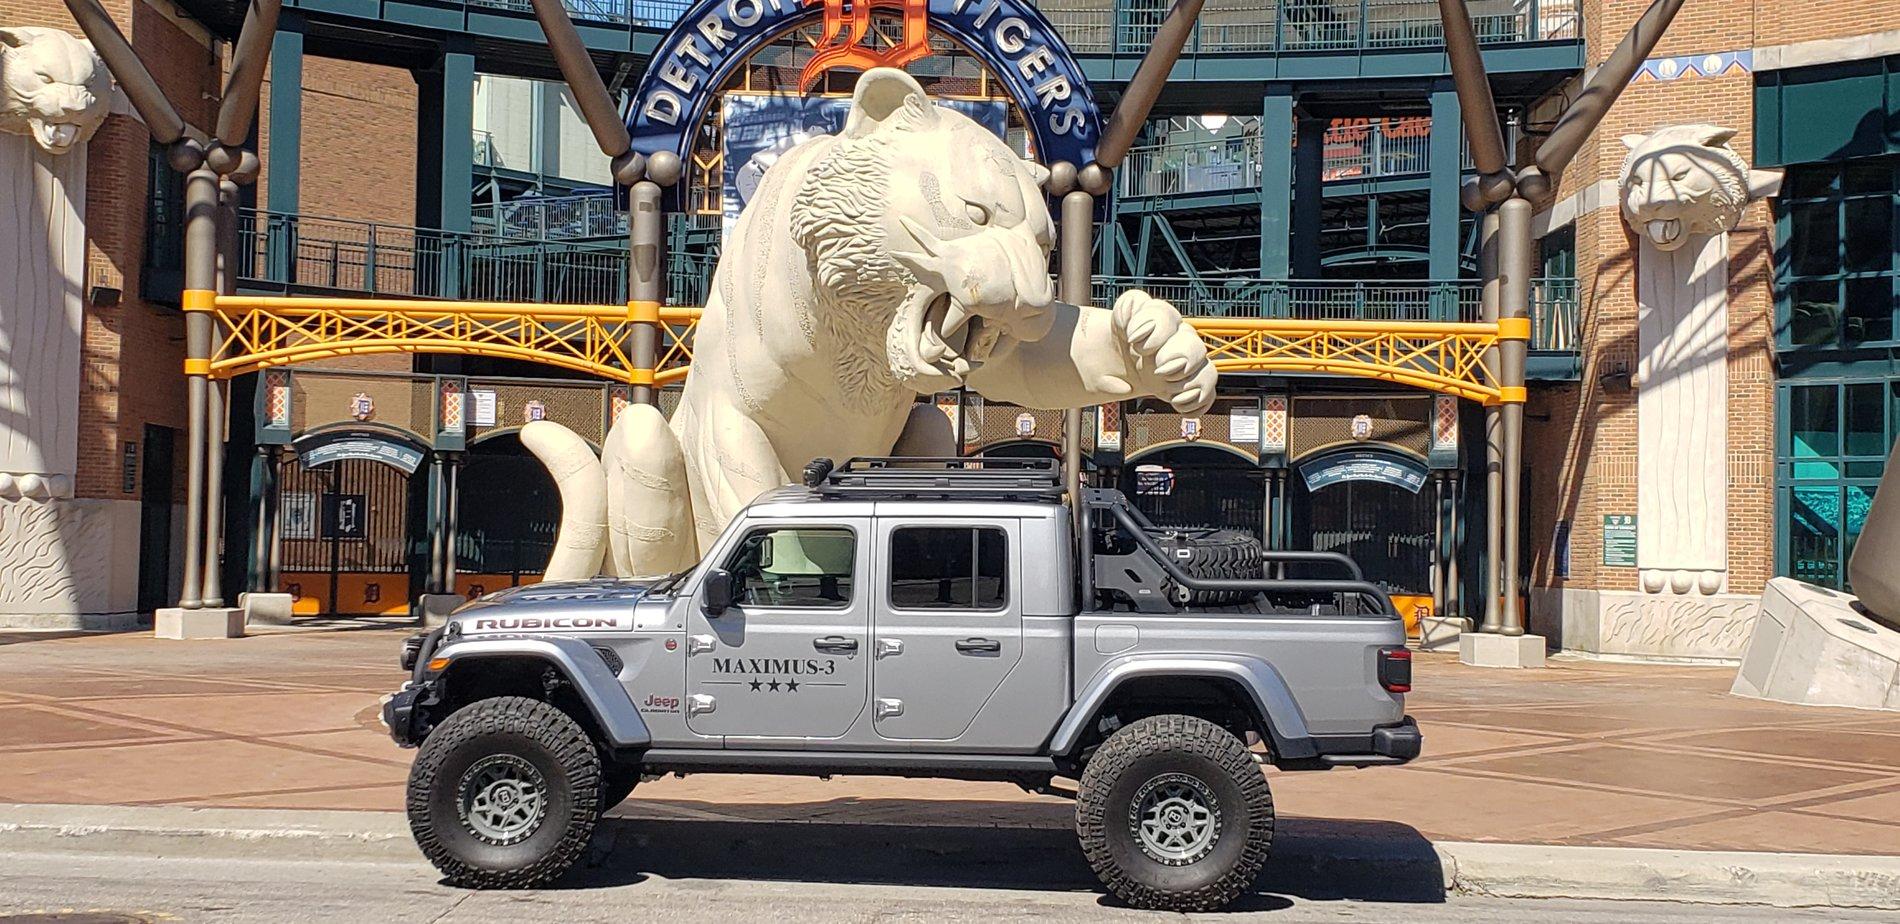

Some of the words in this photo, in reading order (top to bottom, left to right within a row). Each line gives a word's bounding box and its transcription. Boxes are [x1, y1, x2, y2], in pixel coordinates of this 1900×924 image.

[475, 618, 618, 630] RUBICON
[712, 658, 836, 675] MAXIMUS-3
[643, 694, 680, 709] Jeep
